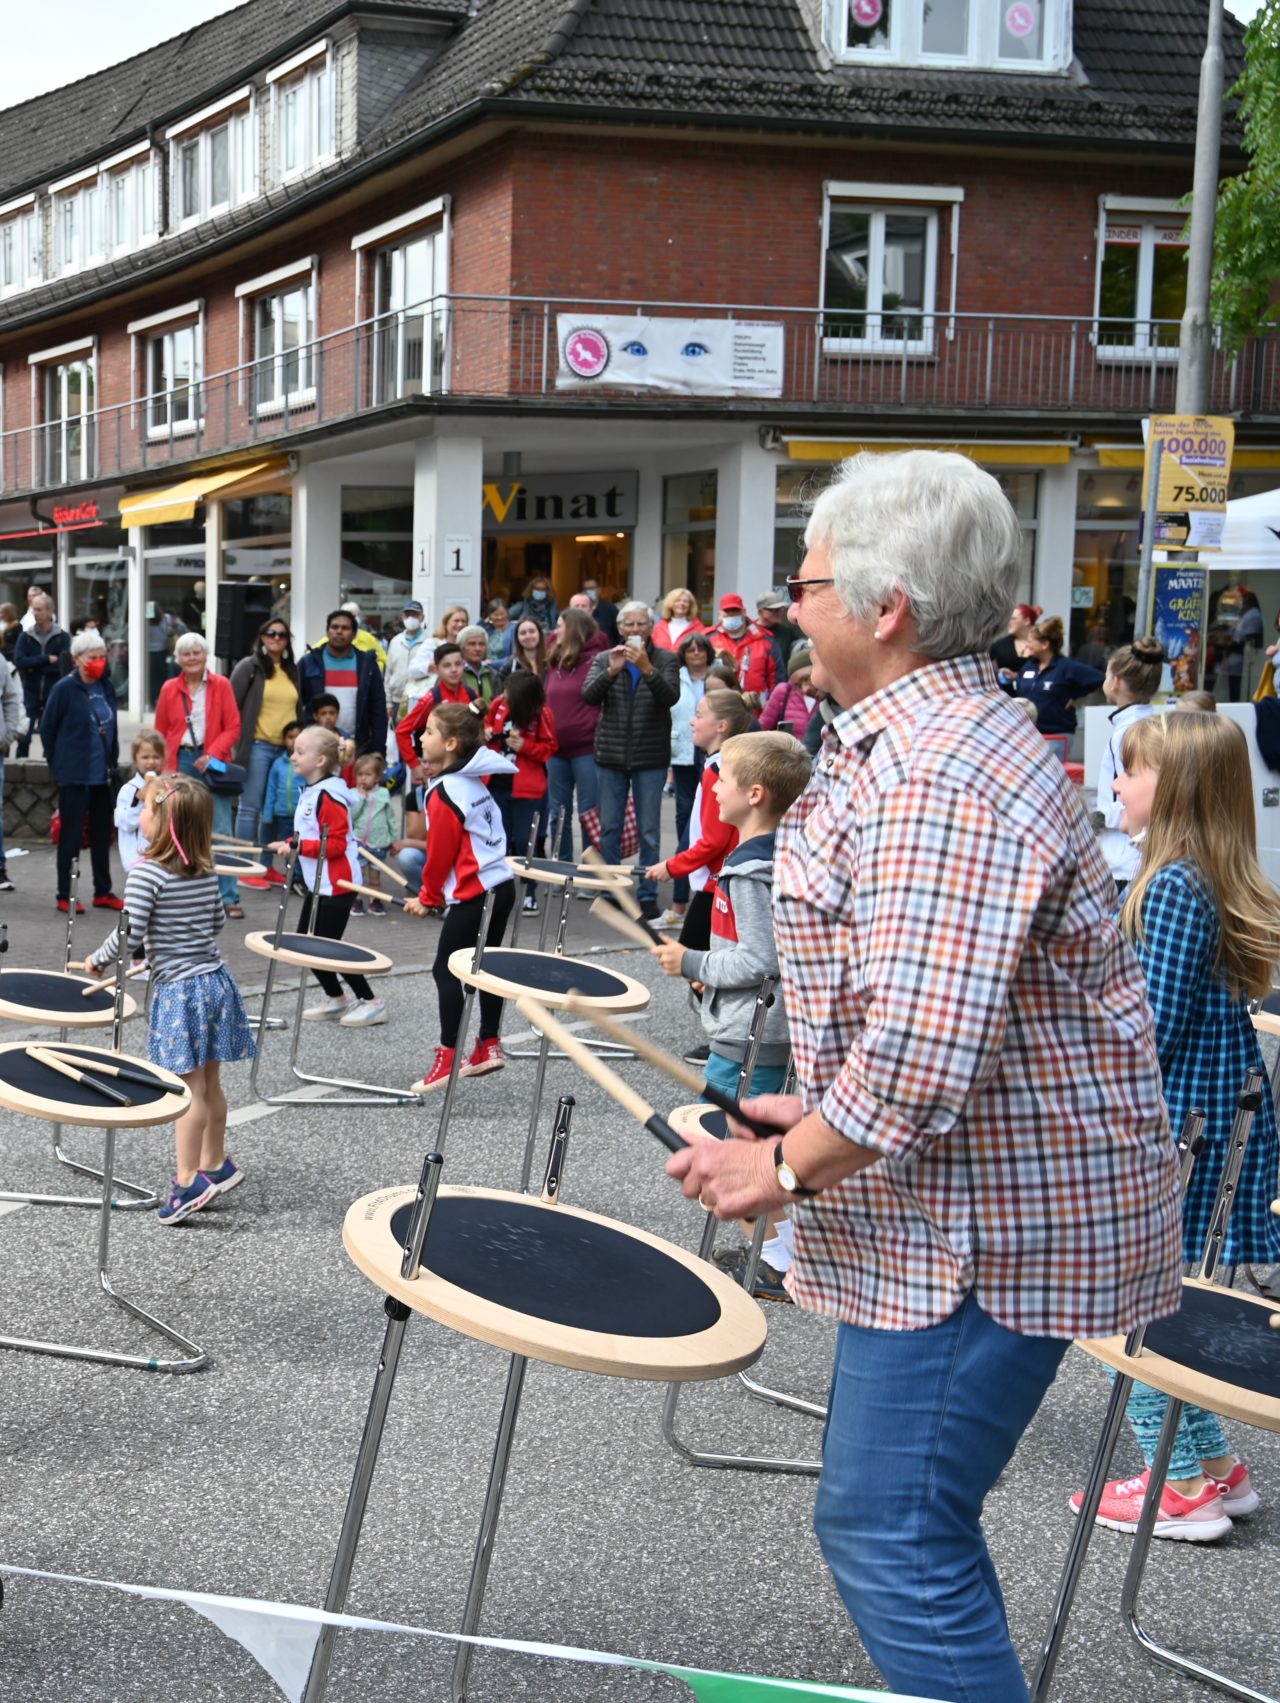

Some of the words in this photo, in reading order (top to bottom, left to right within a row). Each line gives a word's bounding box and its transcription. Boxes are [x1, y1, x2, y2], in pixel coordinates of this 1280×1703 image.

[1105, 229, 1138, 240] INDER
[1172, 485, 1227, 504] 75.000
[451, 547, 464, 571] 1
